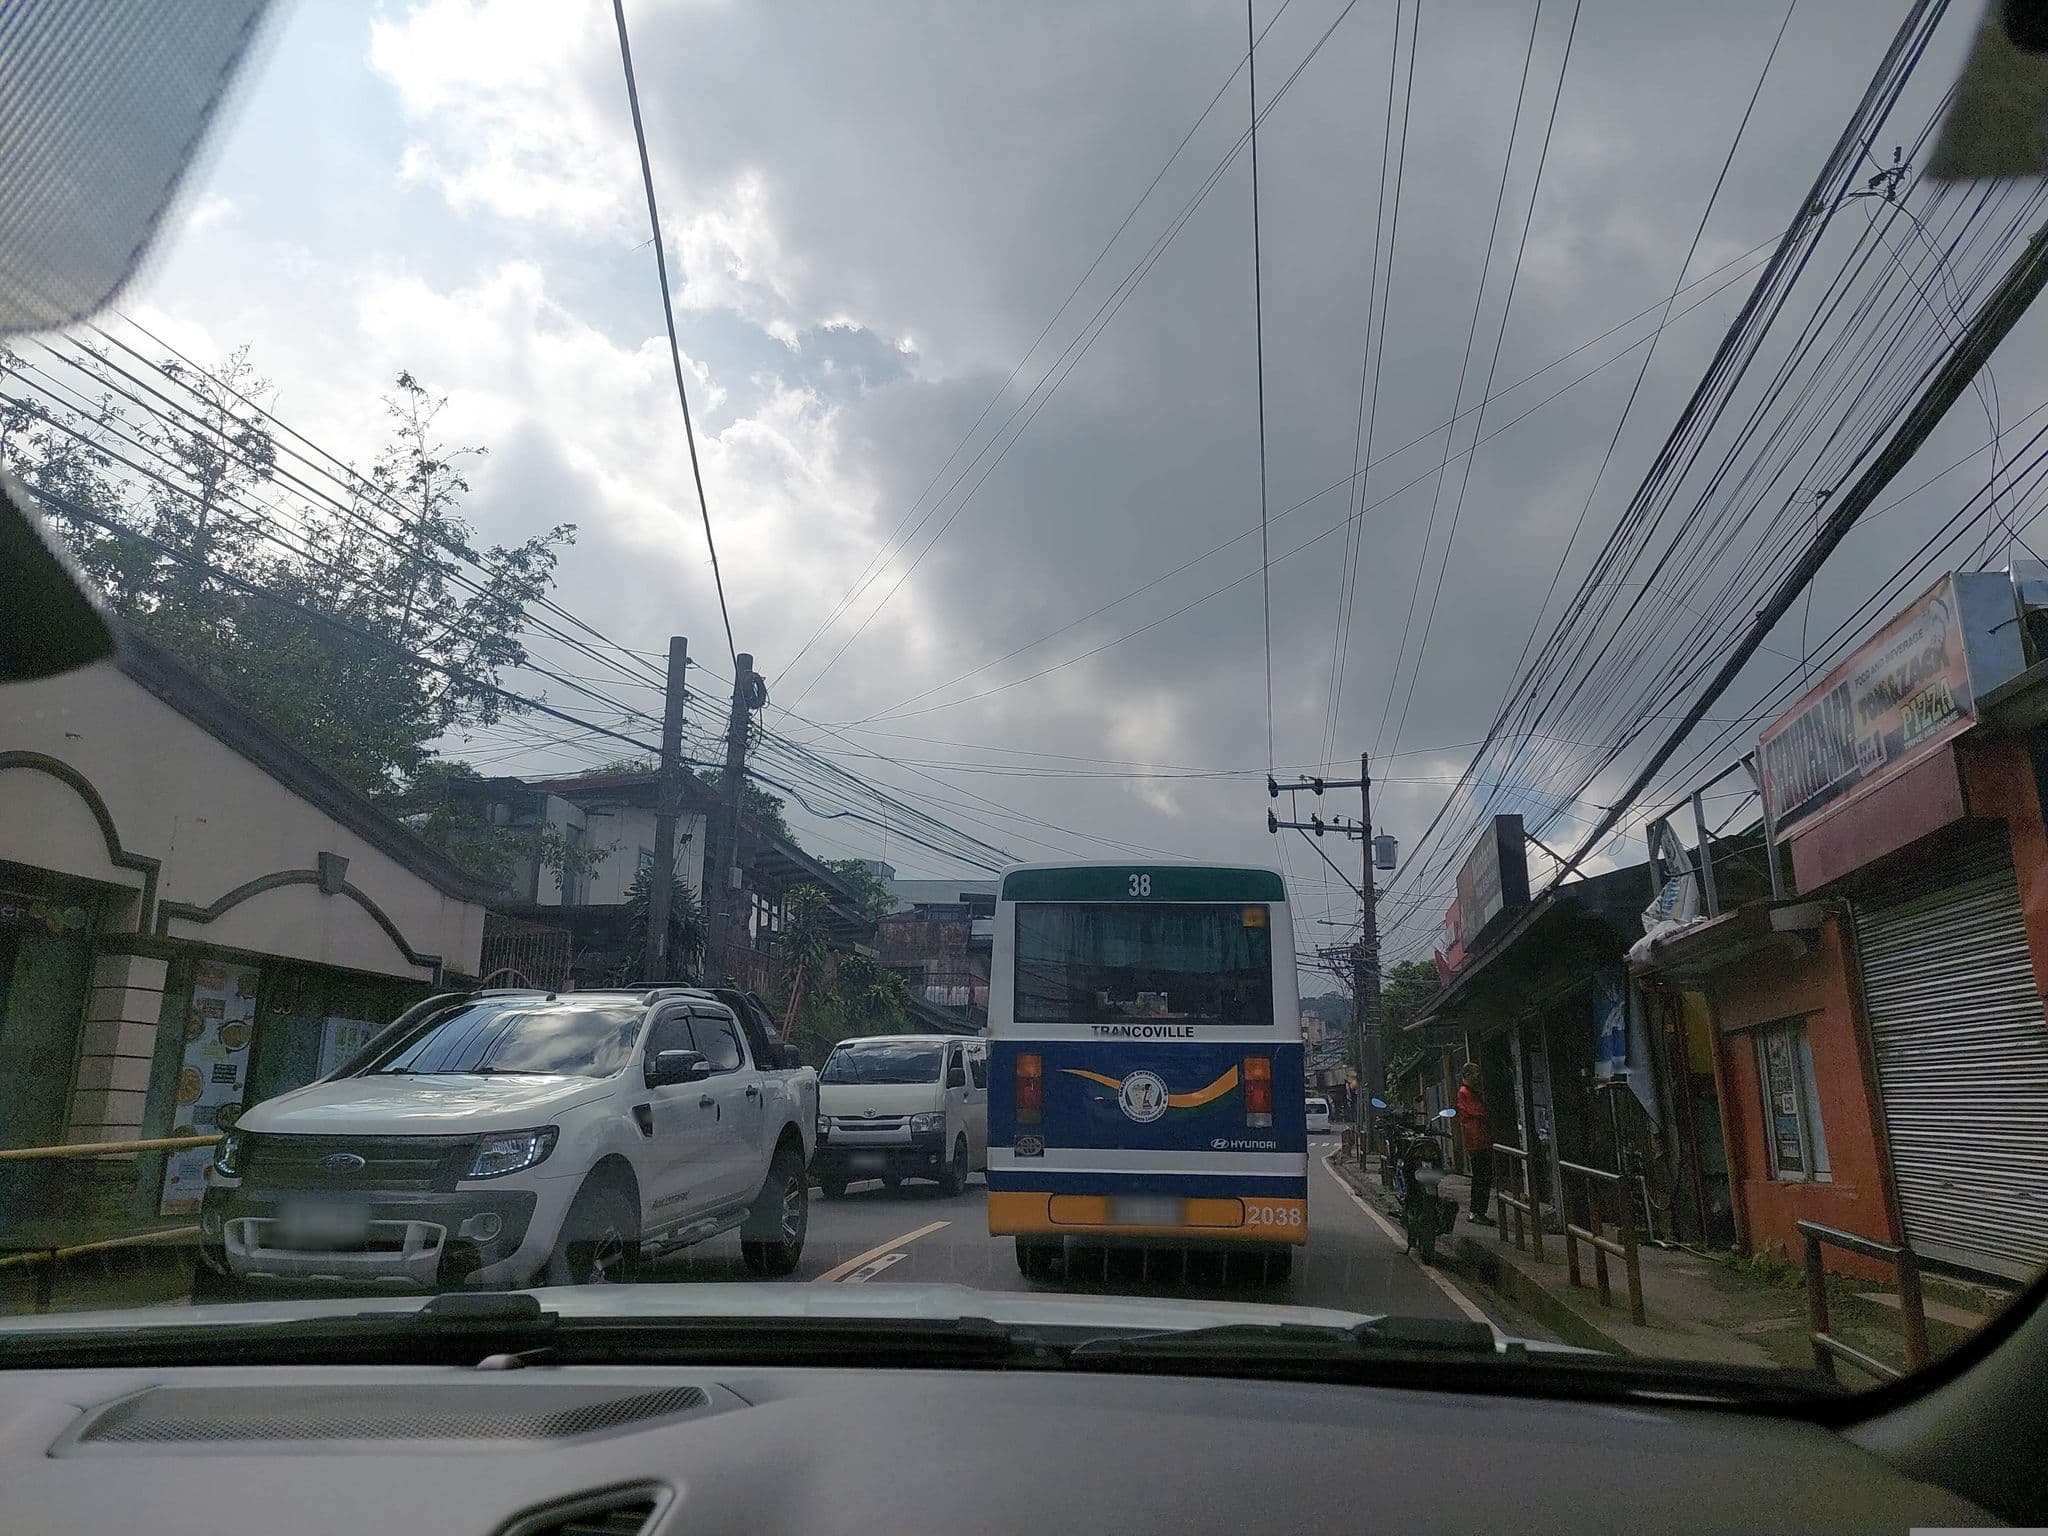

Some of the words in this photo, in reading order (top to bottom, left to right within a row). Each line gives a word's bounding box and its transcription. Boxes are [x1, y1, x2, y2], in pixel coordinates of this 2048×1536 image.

[1901, 676, 1956, 741] PIZZA
[1128, 874, 1151, 897] 38
[1091, 1025, 1195, 1038] TRANCOVILLE
[1231, 1140, 1276, 1149] HYUNDAI
[1247, 1206, 1301, 1226] 2038
